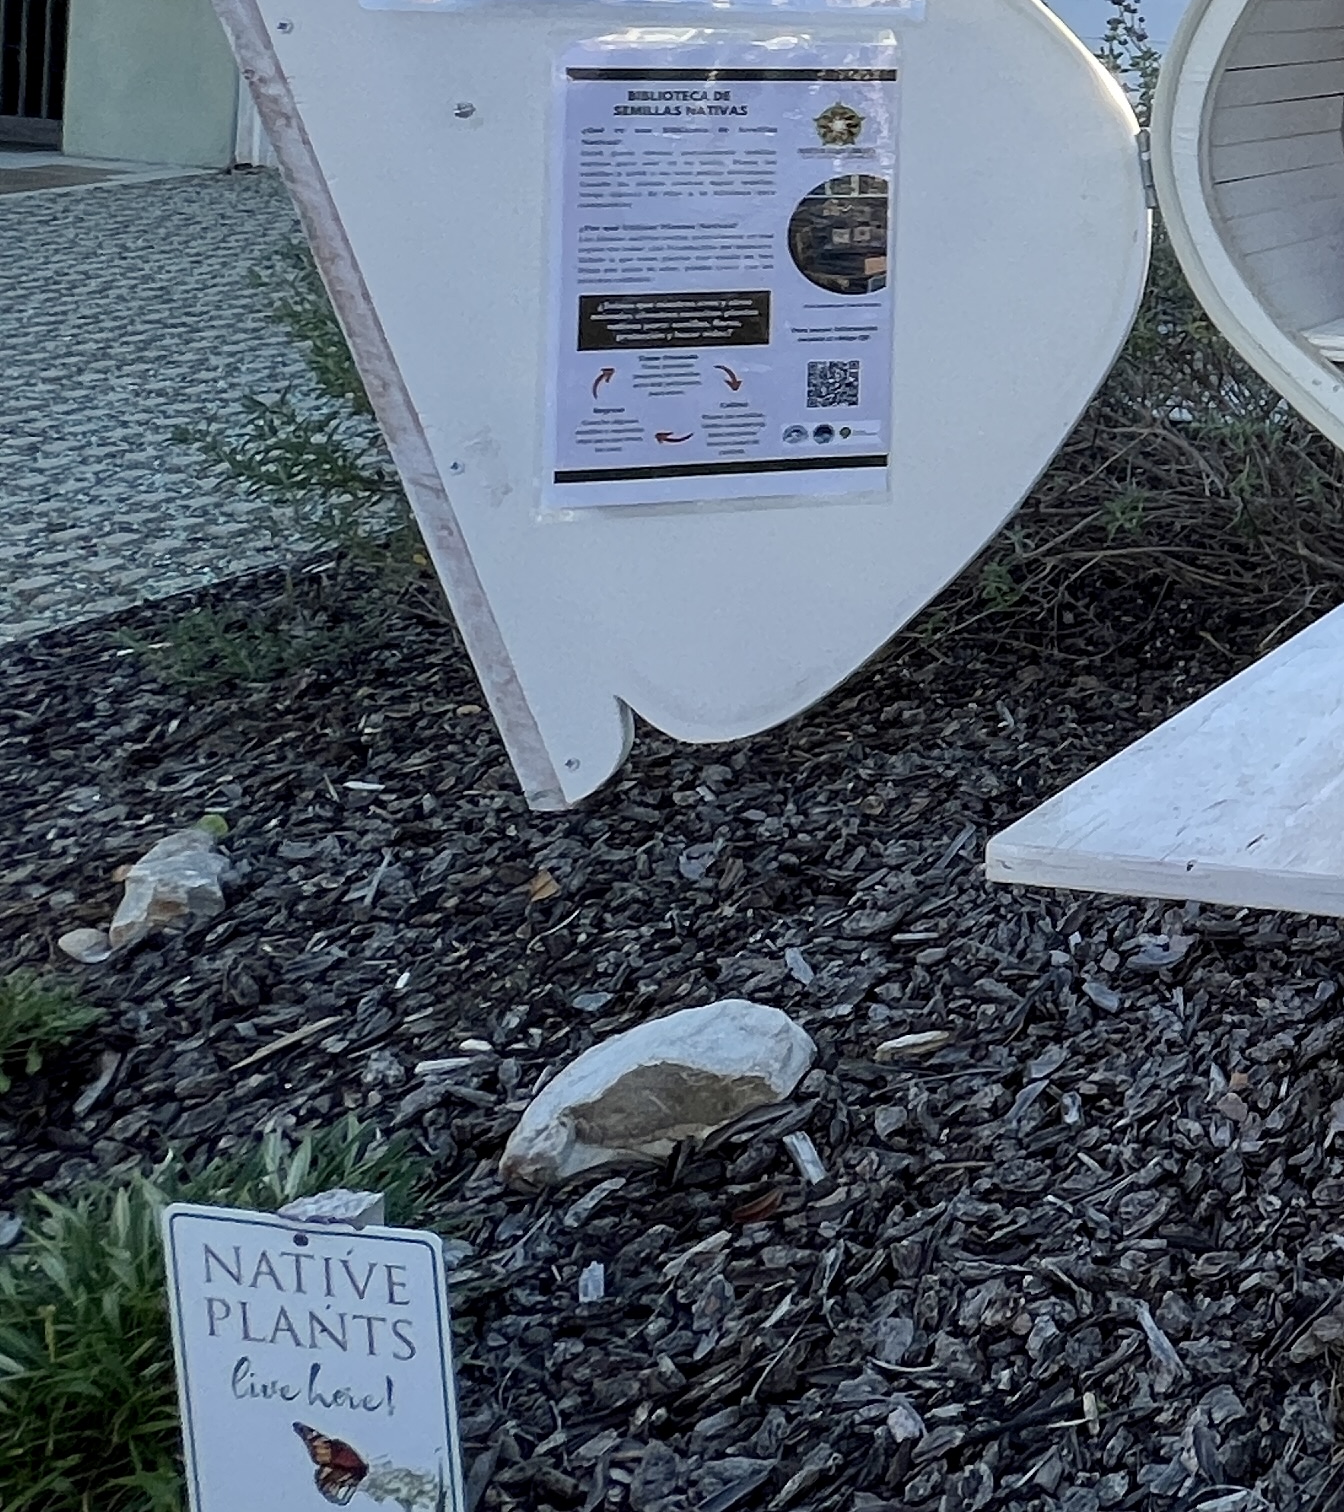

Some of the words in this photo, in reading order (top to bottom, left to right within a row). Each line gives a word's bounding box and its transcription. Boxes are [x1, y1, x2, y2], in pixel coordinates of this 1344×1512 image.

[614, 106, 682, 116] SEMILLAS
[685, 105, 748, 116] NATIVAS
[628, 91, 709, 101] BIBLIOTECA
[714, 91, 731, 101] DE
[202, 1243, 411, 1306] NATIVE
[204, 1296, 418, 1361] PLANTS
[231, 1355, 300, 1401] live
[307, 1362, 396, 1416] here!
